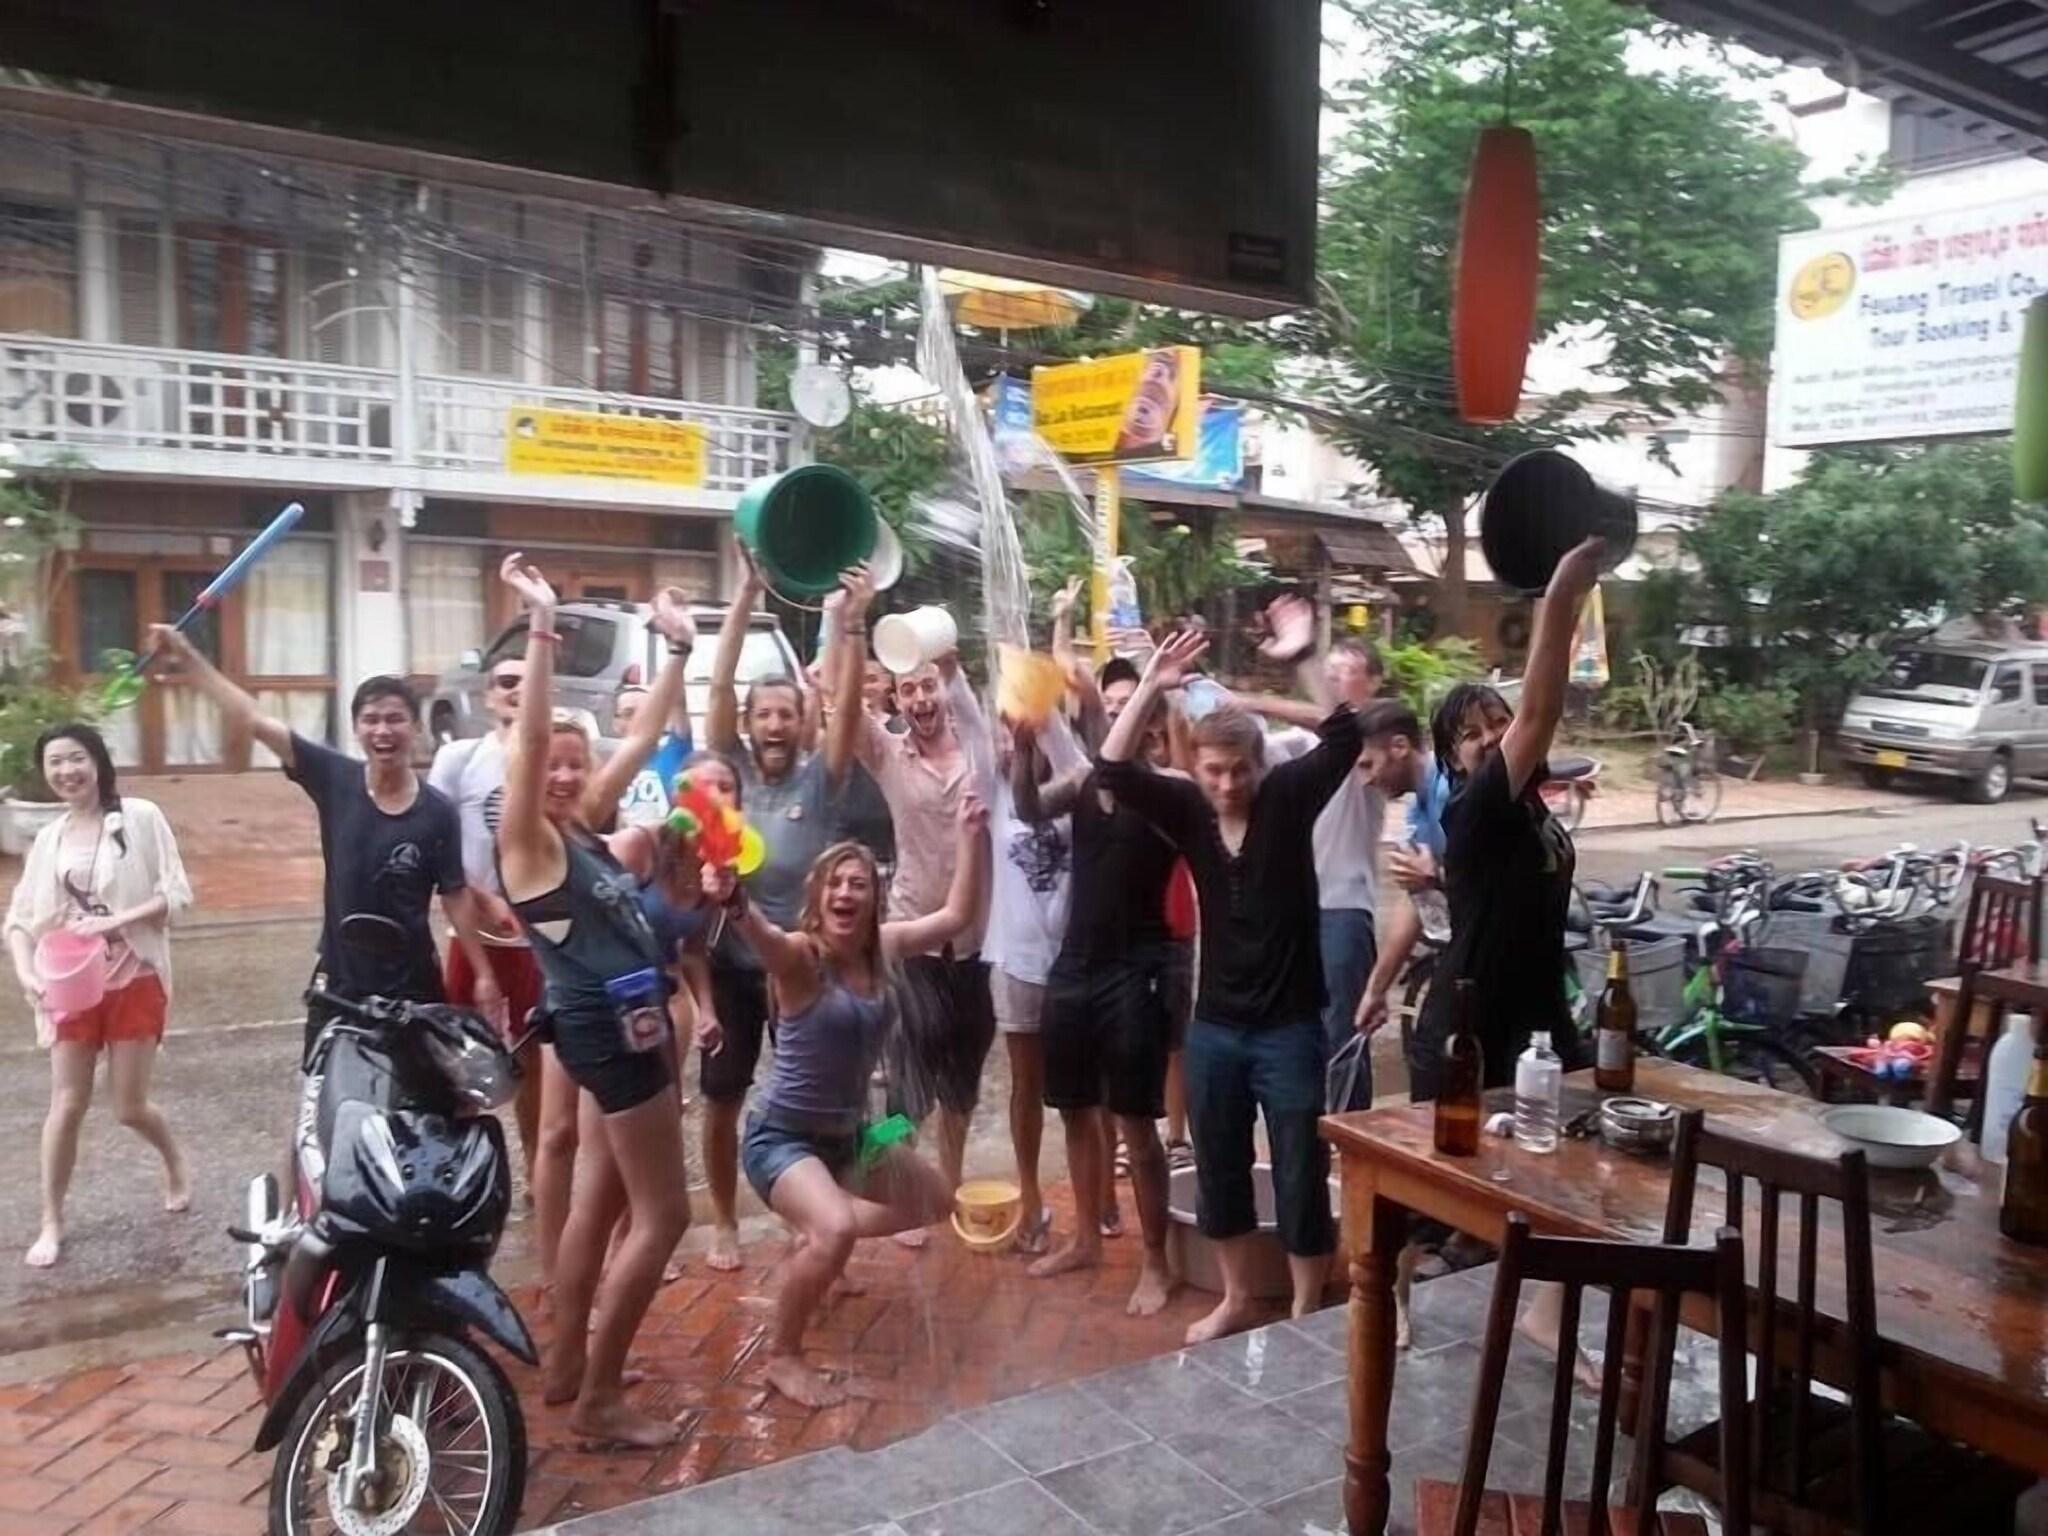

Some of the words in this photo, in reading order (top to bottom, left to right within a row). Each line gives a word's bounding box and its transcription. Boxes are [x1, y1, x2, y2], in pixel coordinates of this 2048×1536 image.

[1937, 274, 2001, 308] Travel
[1870, 326, 1909, 348] Tour
[1917, 316, 1990, 342] Booking
[1997, 310, 2013, 333] &
